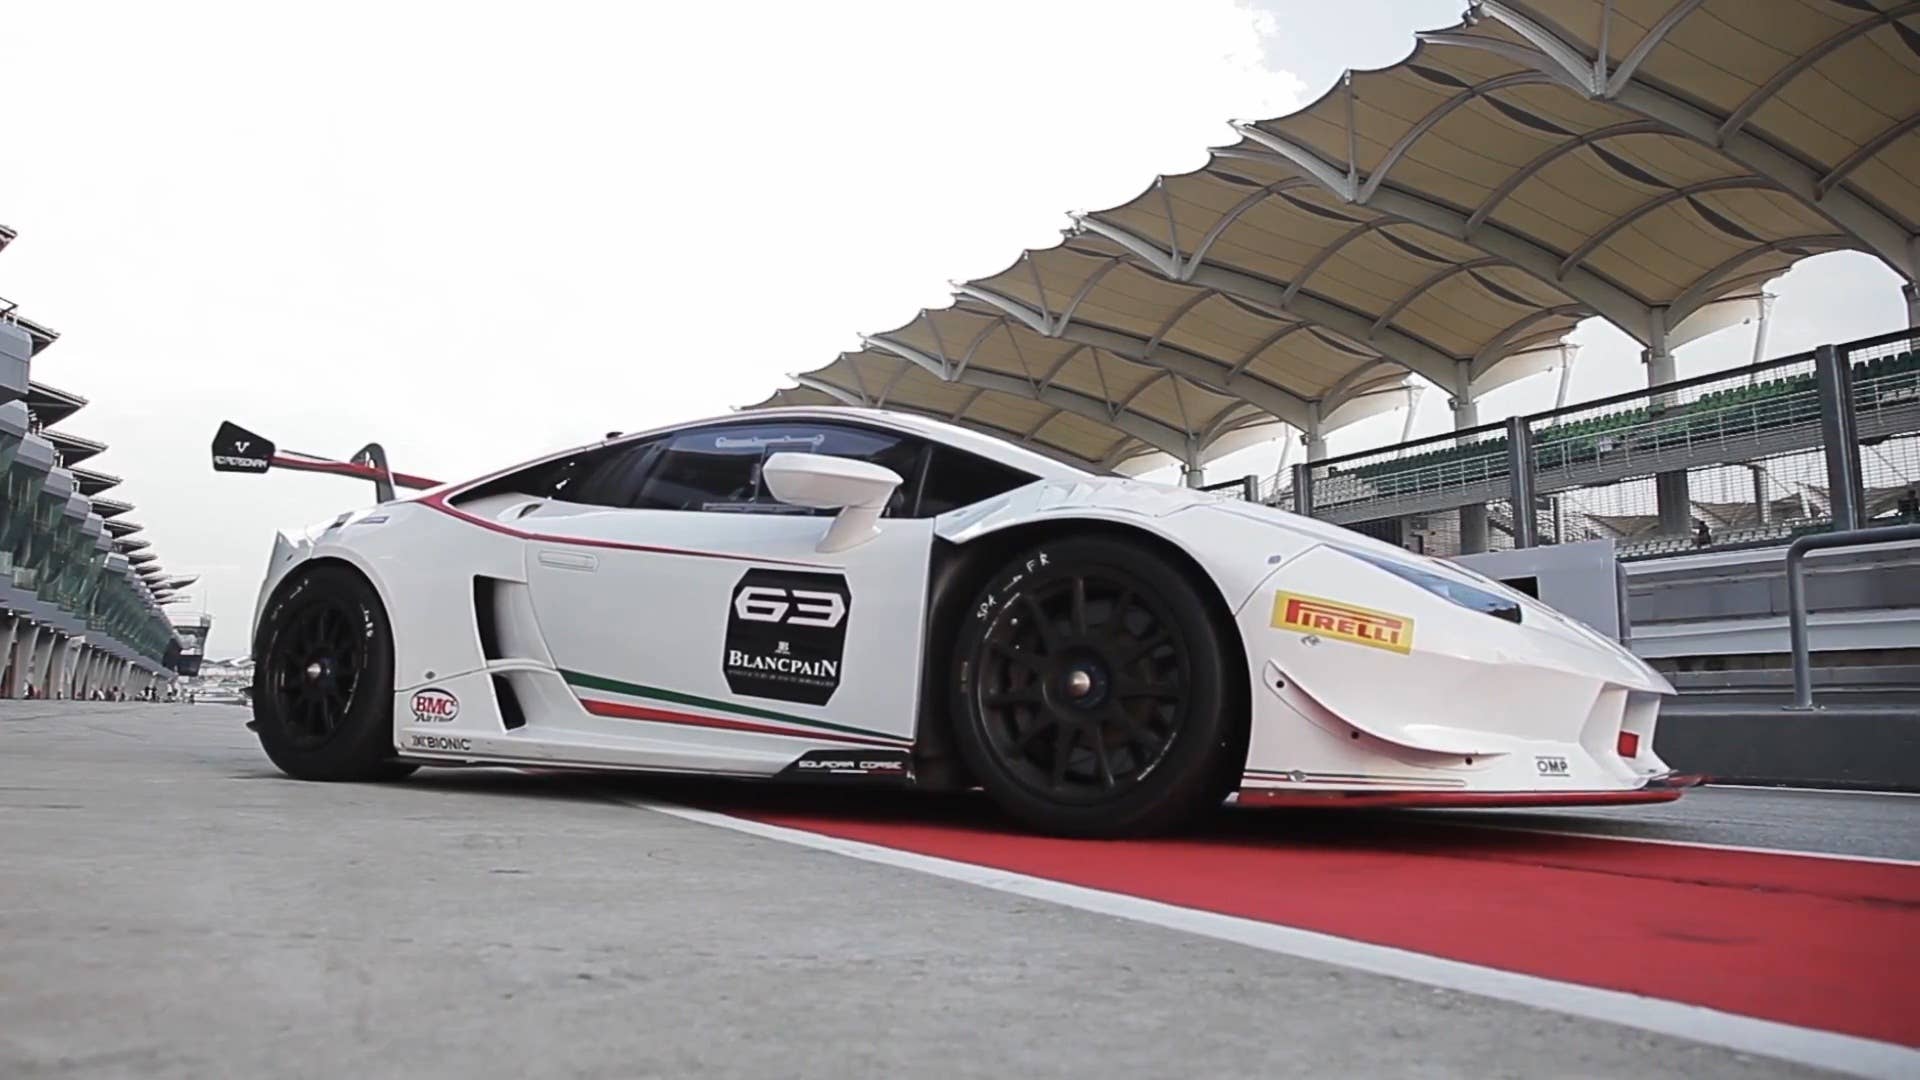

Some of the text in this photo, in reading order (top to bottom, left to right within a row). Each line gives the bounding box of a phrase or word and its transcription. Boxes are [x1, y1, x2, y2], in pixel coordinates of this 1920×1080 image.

[735, 586, 846, 628] 63
[1286, 598, 1403, 644] PIRELLI
[729, 650, 838, 677] BLANCPAIN
[416, 696, 455, 716] BMC
[1537, 760, 1568, 773] OMP
